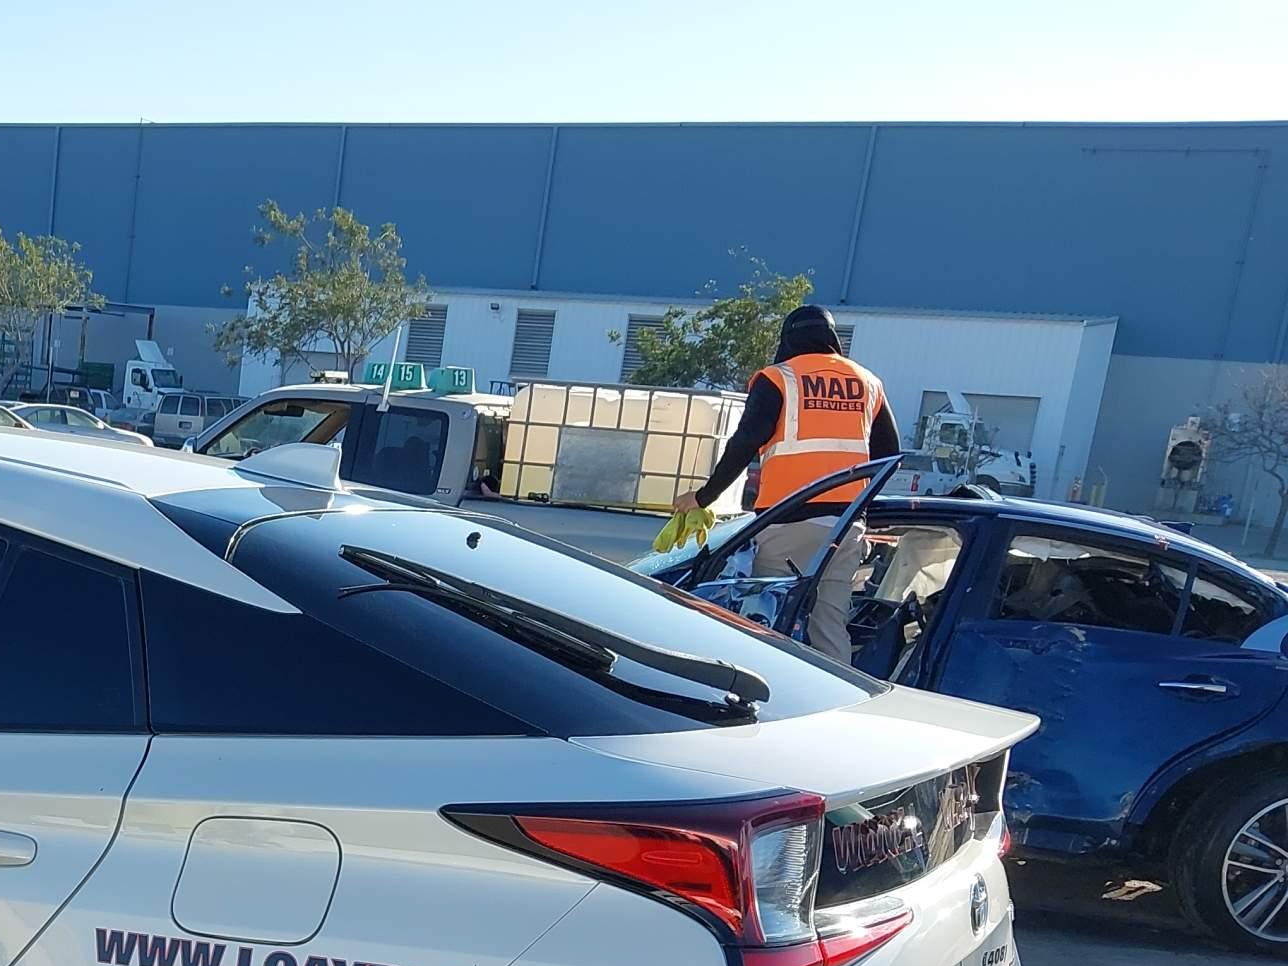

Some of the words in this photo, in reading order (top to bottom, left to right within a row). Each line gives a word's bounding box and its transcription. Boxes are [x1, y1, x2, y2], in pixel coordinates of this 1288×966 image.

[372, 363, 385, 379] 14
[400, 364, 413, 381] 15
[454, 370, 466, 386] 13
[801, 374, 865, 400] MAD
[808, 400, 862, 410] SERVICES
